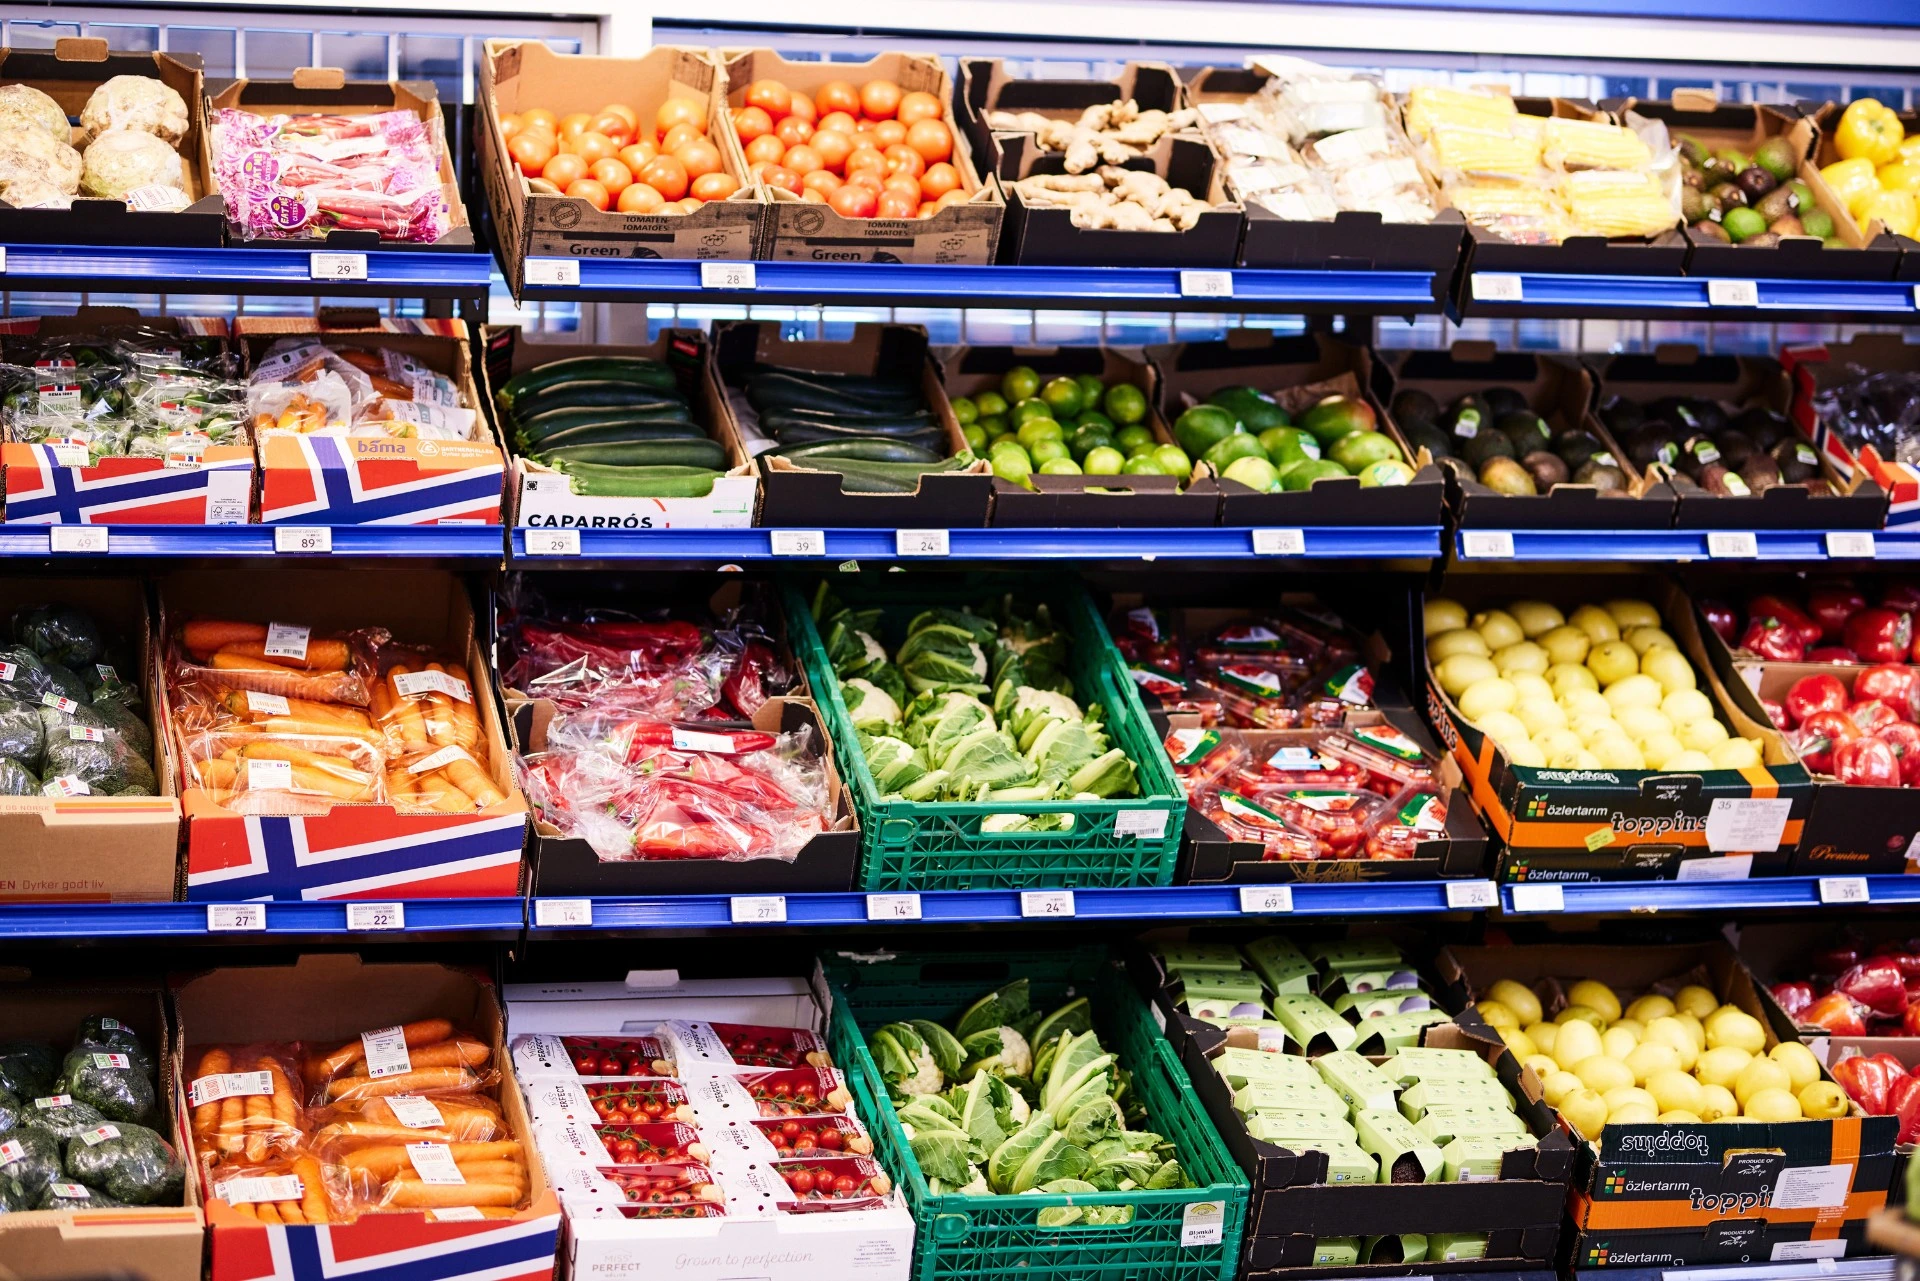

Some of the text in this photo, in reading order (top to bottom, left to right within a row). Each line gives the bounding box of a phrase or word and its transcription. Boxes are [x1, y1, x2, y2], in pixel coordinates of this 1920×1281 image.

[279, 196, 290, 224] EAT ME
[569, 243, 620, 256] Green
[811, 249, 861, 261] Green
[337, 265, 351, 275] 29
[557, 271, 564, 281] 8
[726, 274, 740, 284] 28
[1205, 282, 1217, 292] 39
[528, 513, 653, 529] CAPARRÓS
[77, 538, 92, 548] 49
[301, 538, 316, 548] 89
[551, 541, 564, 551] 29
[796, 542, 809, 552] 39
[920, 541, 934, 551] 24
[1277, 540, 1290, 550] 26
[1547, 803, 1608, 816] özlertarım
[1718, 801, 1732, 810] 35
[1610, 810, 1708, 837] toppins
[1809, 844, 1870, 861] Premium
[1528, 869, 1589, 881] özlertarım
[22, 880, 59, 891] Dyrker
[62, 880, 89, 891] godt
[92, 880, 104, 889] liv
[1470, 893, 1484, 903] 24
[1842, 888, 1855, 898] 39
[1045, 903, 1060, 913] 24
[1264, 898, 1277, 908] 69
[563, 911, 576, 921] 14
[757, 908, 771, 918] 27
[894, 906, 906, 916] 14
[235, 916, 249, 927] 27
[373, 915, 388, 925] 22
[683, 1031, 694, 1048] MISS
[690, 1029, 704, 1052] PERFECT
[527, 1040, 536, 1057] MISS
[534, 1037, 547, 1062] PERFECT
[709, 1081, 724, 1103] PERFECT
[566, 1128, 581, 1149] PERFECT
[1621, 1131, 1709, 1157] toppins
[1625, 1179, 1690, 1192] özlertarım
[604, 1254, 630, 1262] MISS
[675, 1251, 814, 1270] Grown to perfection
[1609, 1251, 1672, 1264] özlertarım
[592, 1263, 641, 1272] PERFECT
